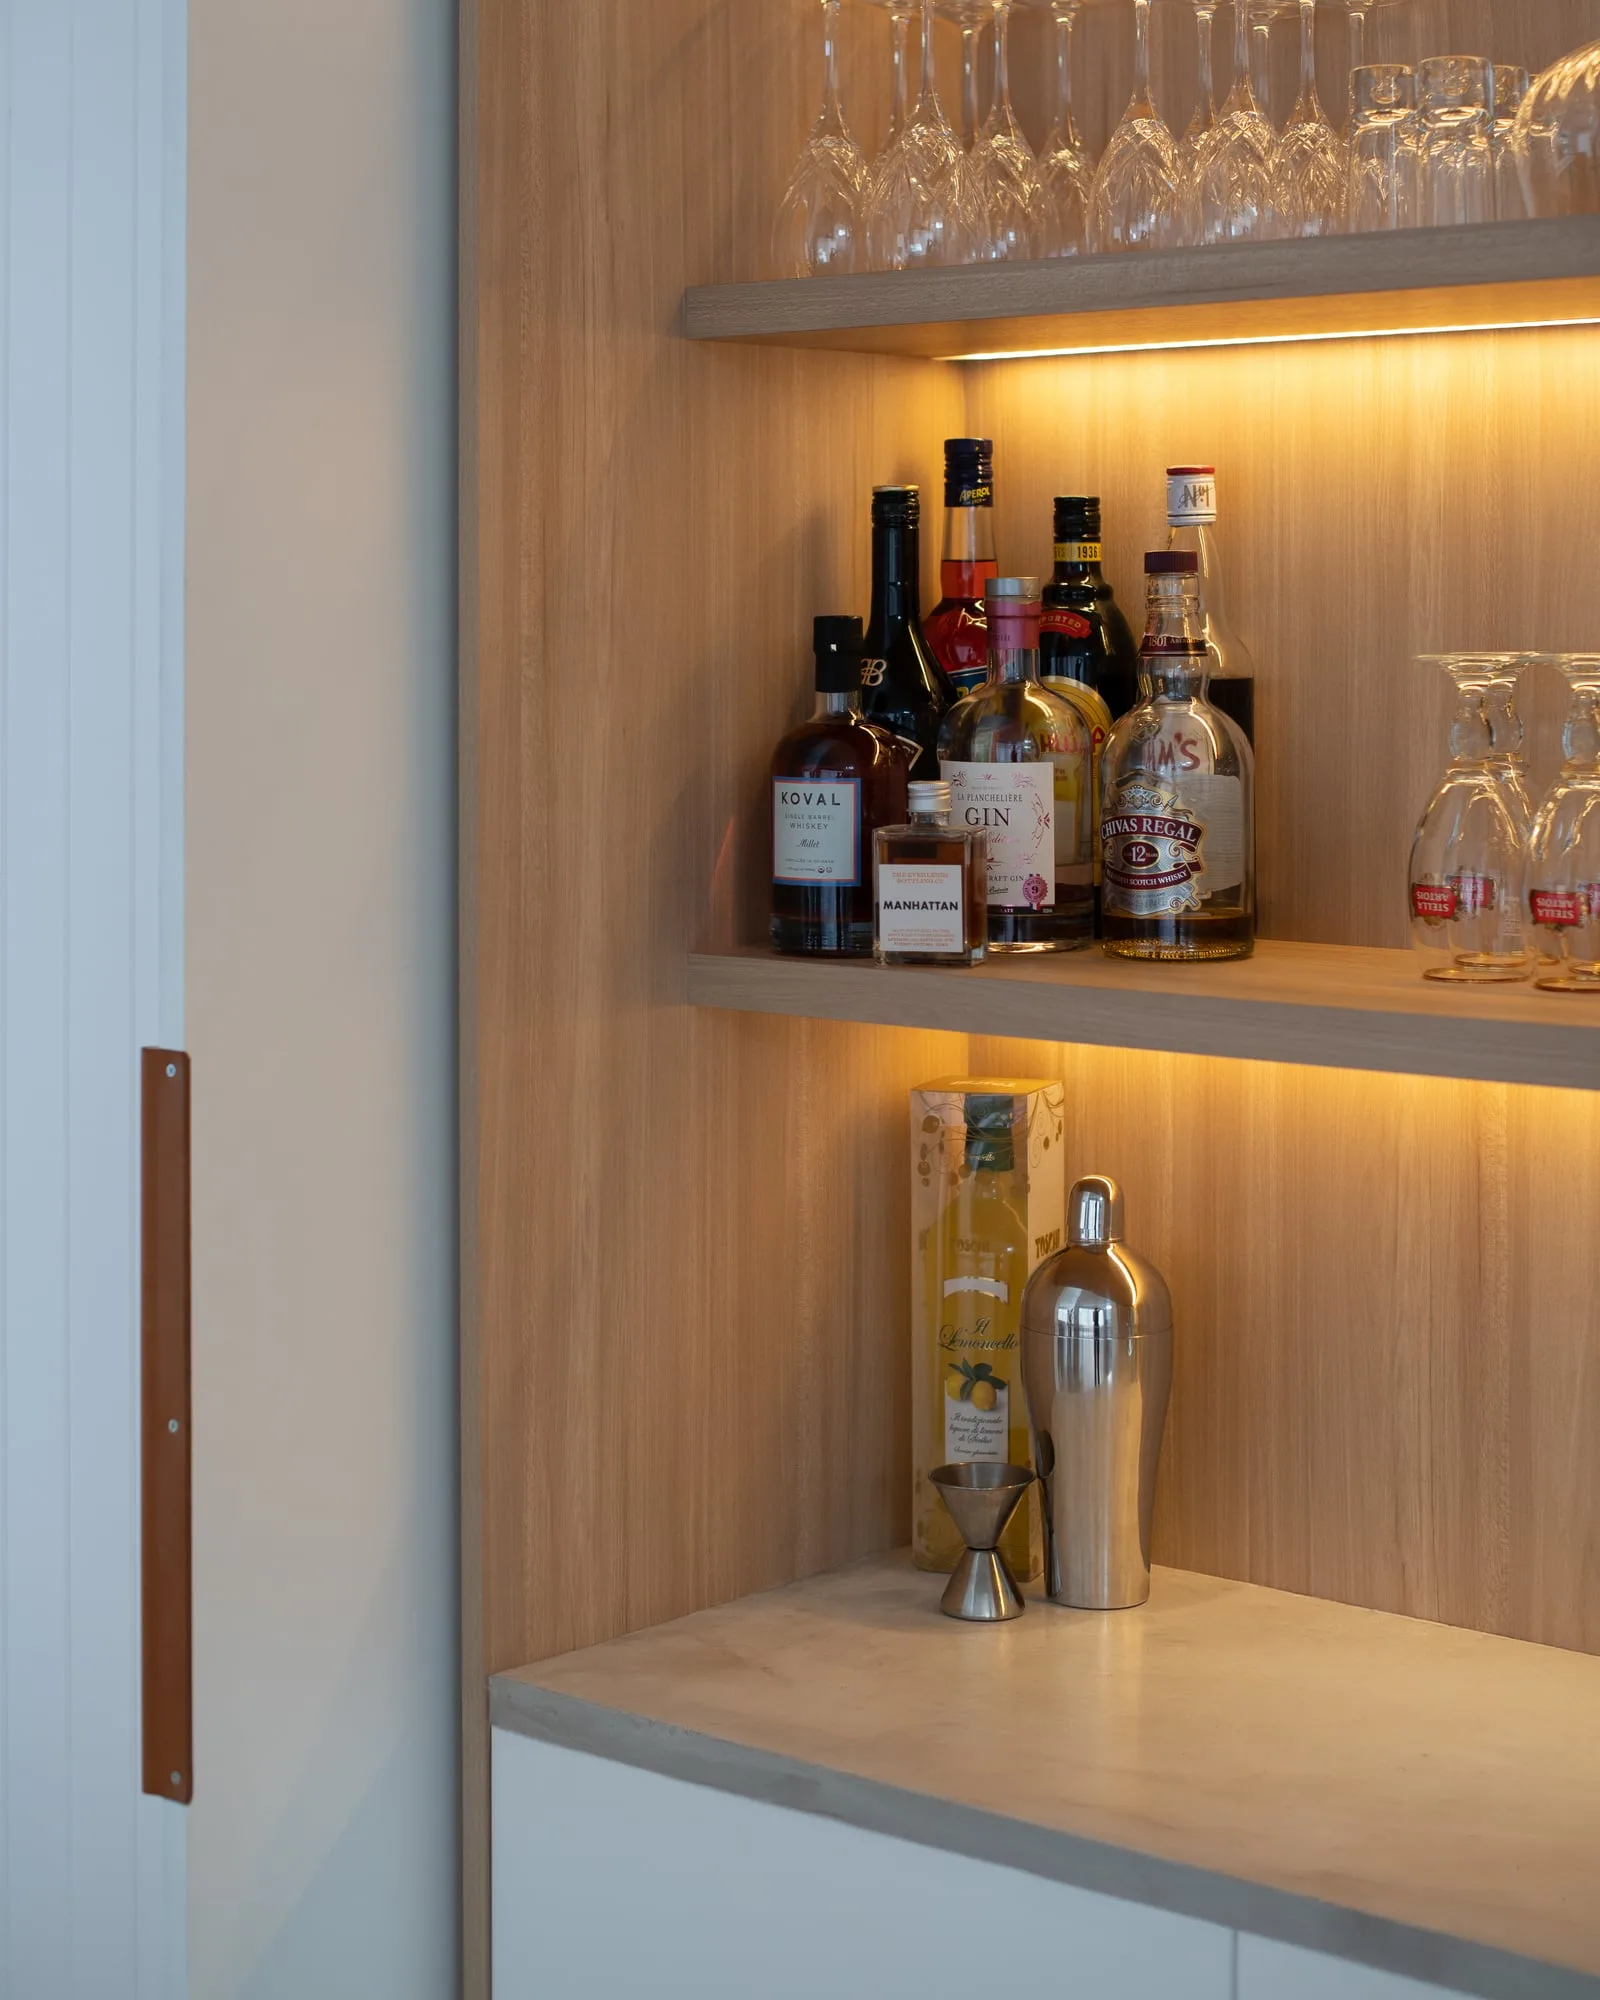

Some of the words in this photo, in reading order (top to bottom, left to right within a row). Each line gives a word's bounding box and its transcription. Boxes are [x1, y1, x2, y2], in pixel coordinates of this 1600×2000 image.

[959, 486, 990, 502] APEROL
[1077, 545, 1098, 559] 1936
[781, 791, 841, 806] KOVAL
[964, 807, 1011, 827] GIN
[789, 822, 829, 831] WHISKEY
[1101, 818, 1138, 839] CHIVAS
[1142, 818, 1196, 842] REGAL
[1131, 845, 1147, 862] 12
[1010, 874, 1024, 882] GIN
[1129, 878, 1157, 886] SCOTCH
[1158, 869, 1188, 884] WHISKY
[1031, 884, 1039, 894] 9
[1416, 890, 1449, 901] ARTOIS
[883, 900, 959, 911] MANHATTAN
[1417, 901, 1449, 912] STELLA
[1536, 908, 1575, 919] STELLA
[1035, 1228, 1061, 1259] TOSCHI
